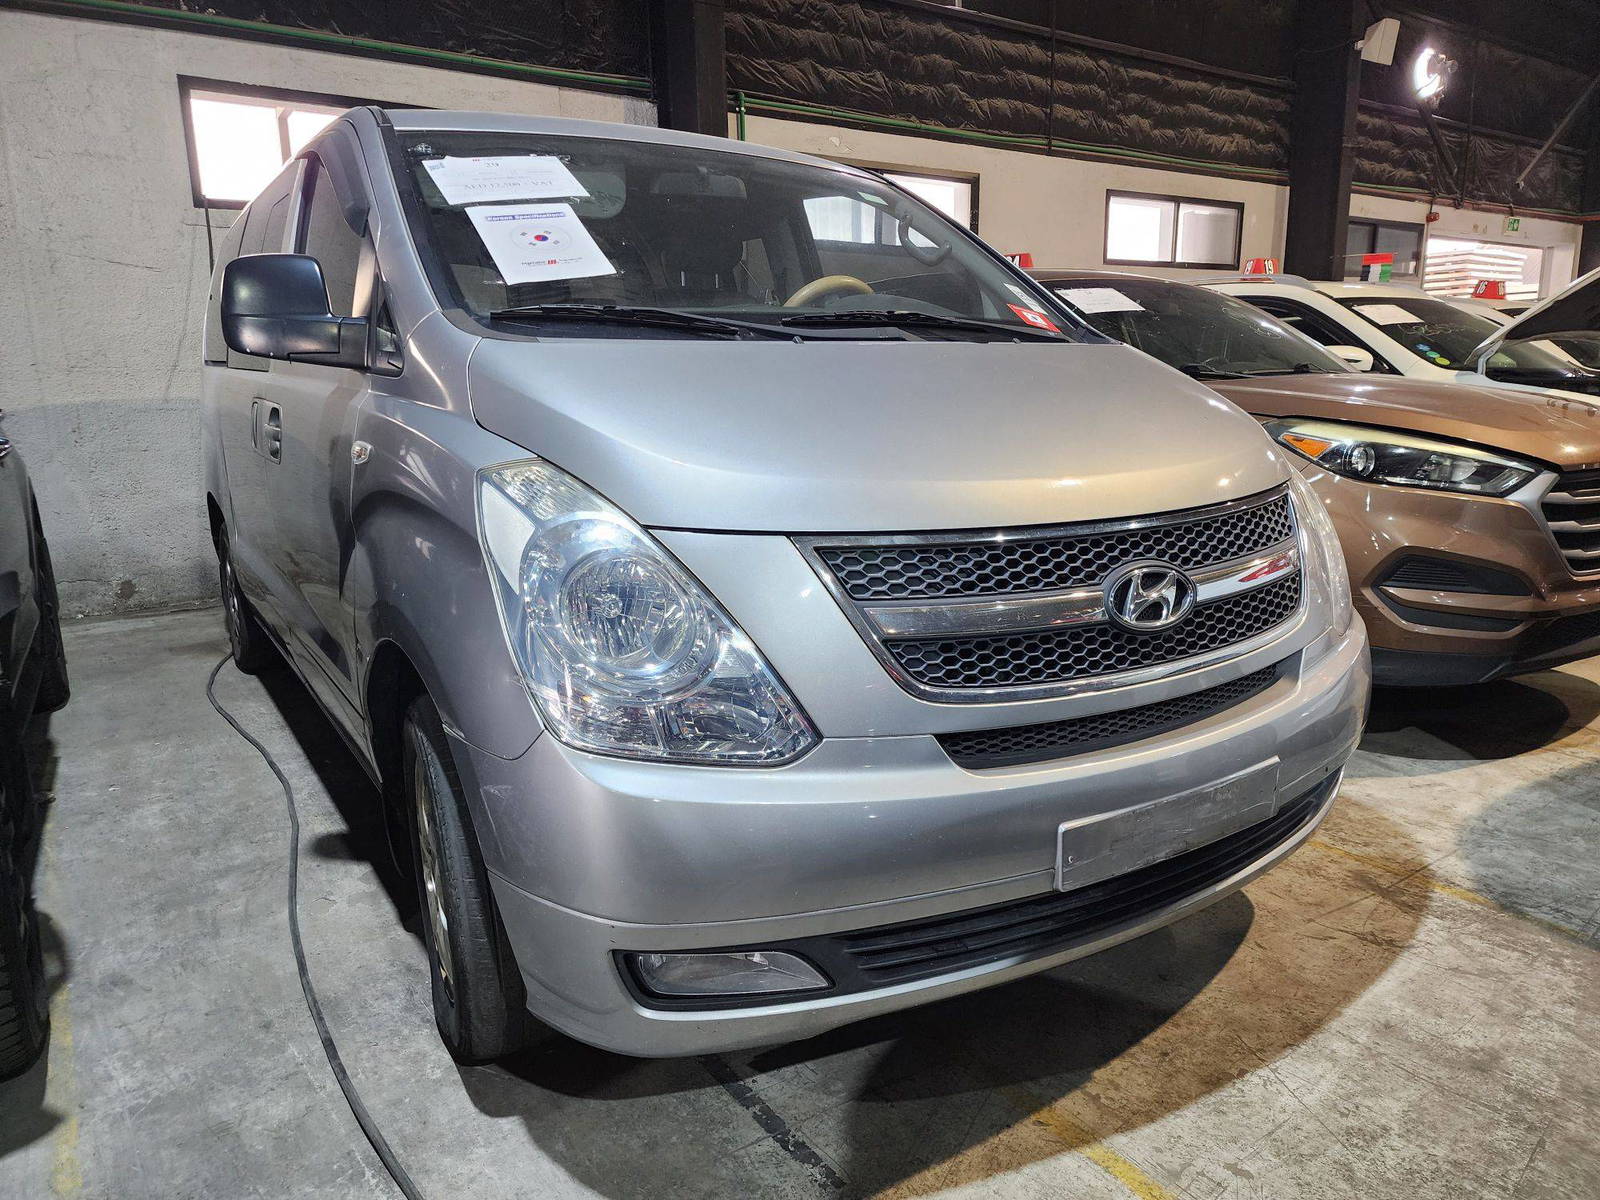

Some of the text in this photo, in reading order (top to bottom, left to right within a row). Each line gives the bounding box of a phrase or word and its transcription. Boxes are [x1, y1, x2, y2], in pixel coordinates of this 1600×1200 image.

[514, 211, 566, 220] Specifications
[1264, 259, 1274, 275] 19
[1475, 280, 1489, 295] 16
